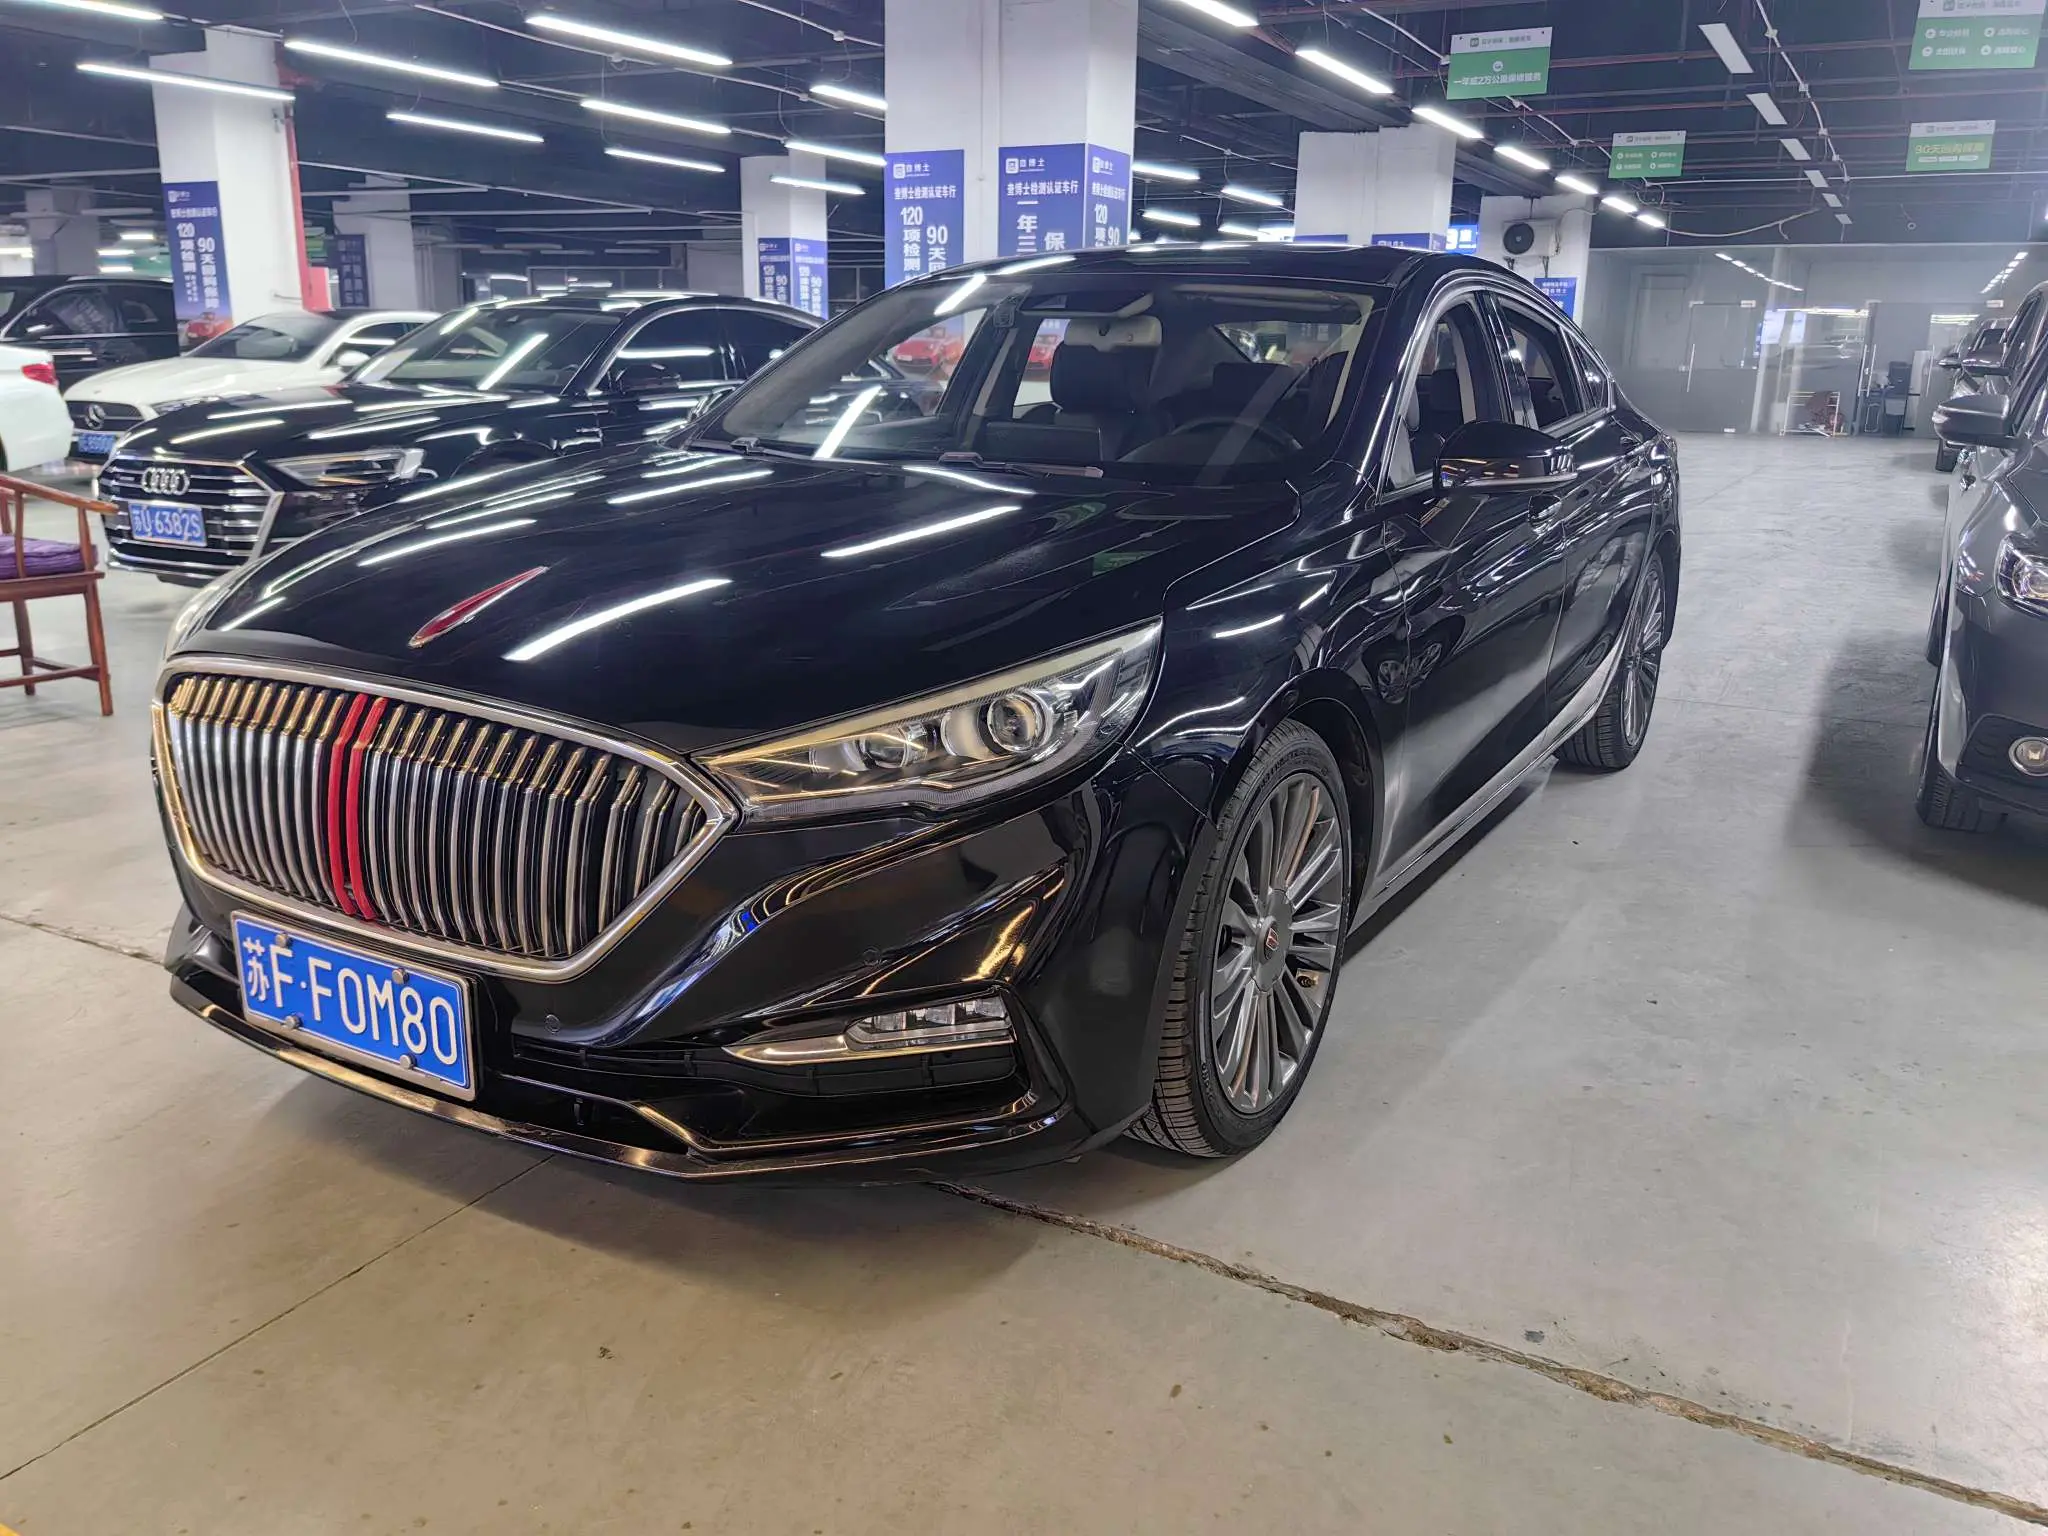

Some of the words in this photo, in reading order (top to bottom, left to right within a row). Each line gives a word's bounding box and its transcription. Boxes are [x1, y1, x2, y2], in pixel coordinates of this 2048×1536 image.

[894, 184, 957, 200] 查博士检测认证车行
[1007, 180, 1079, 196] 查博士检测认证车行
